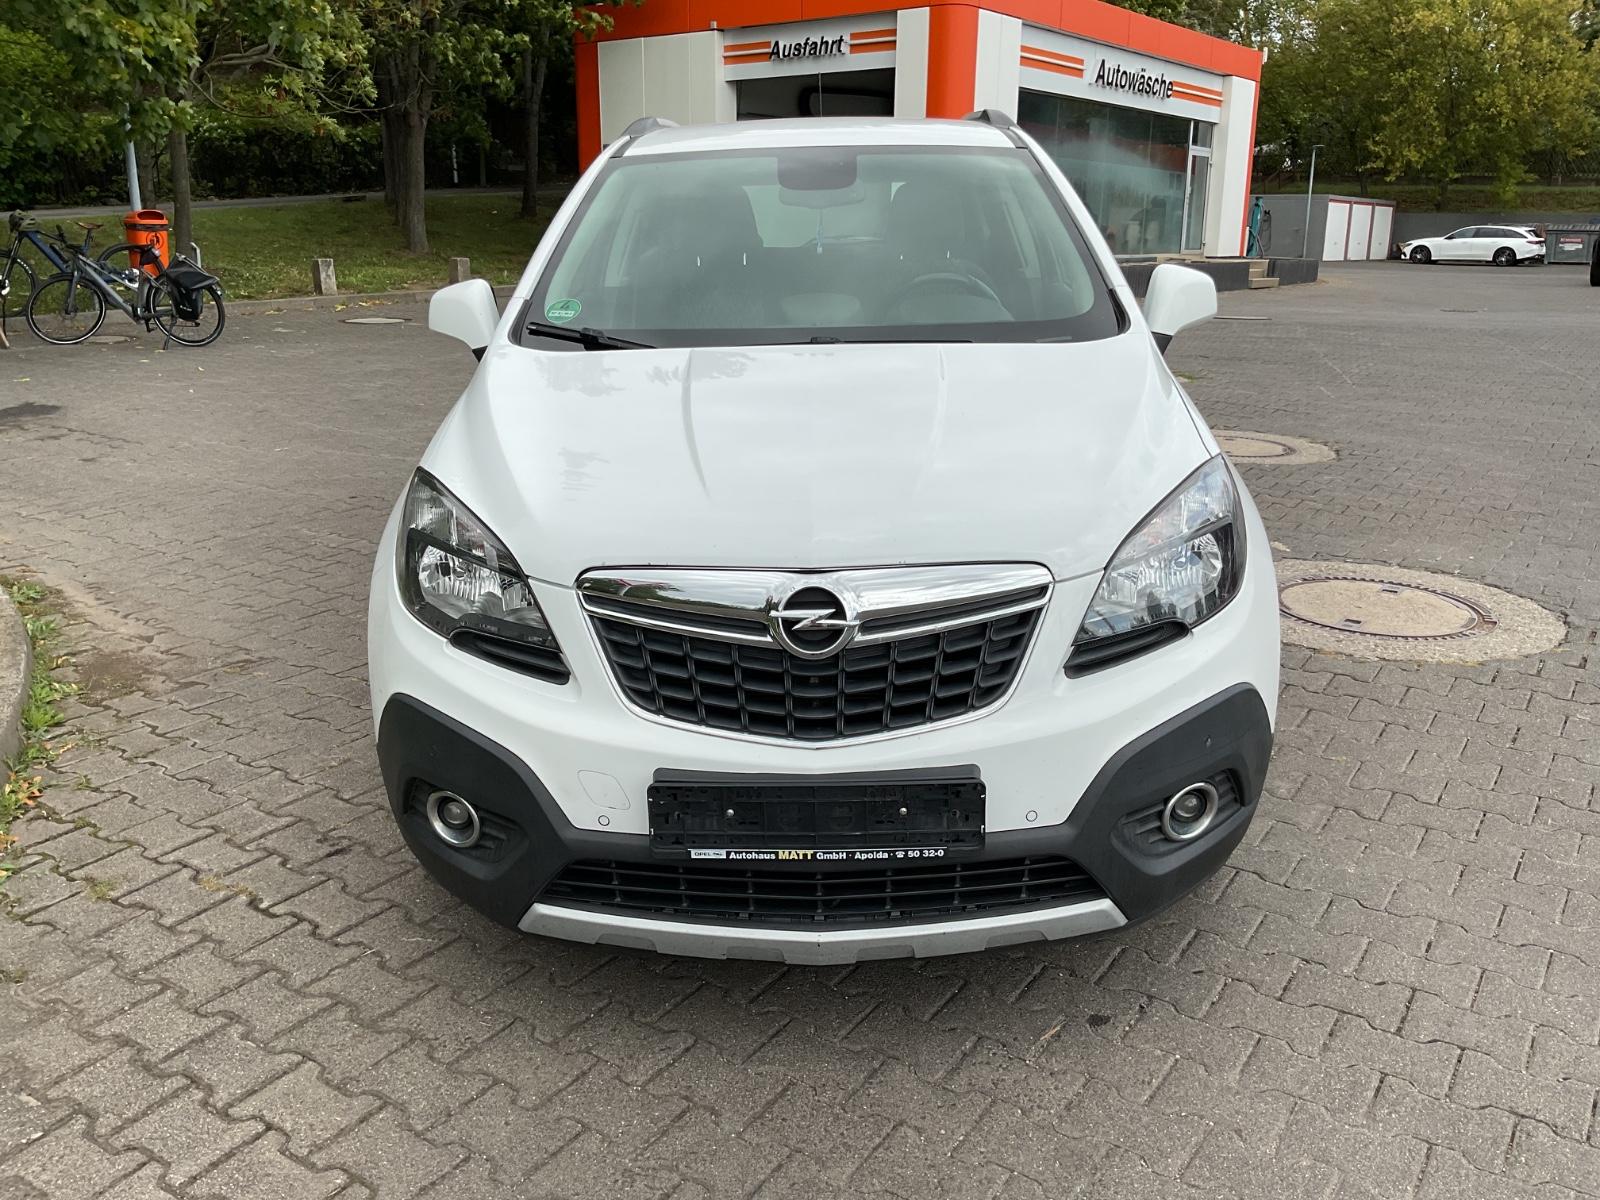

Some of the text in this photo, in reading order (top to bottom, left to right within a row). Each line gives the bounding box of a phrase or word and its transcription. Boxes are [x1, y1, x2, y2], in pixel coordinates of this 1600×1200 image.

[768, 34, 845, 60] Ausfahrt
[1094, 58, 1174, 99] Autowäsche
[729, 849, 945, 861] Autohaus MATT GmbH Apolda 50 32-0
